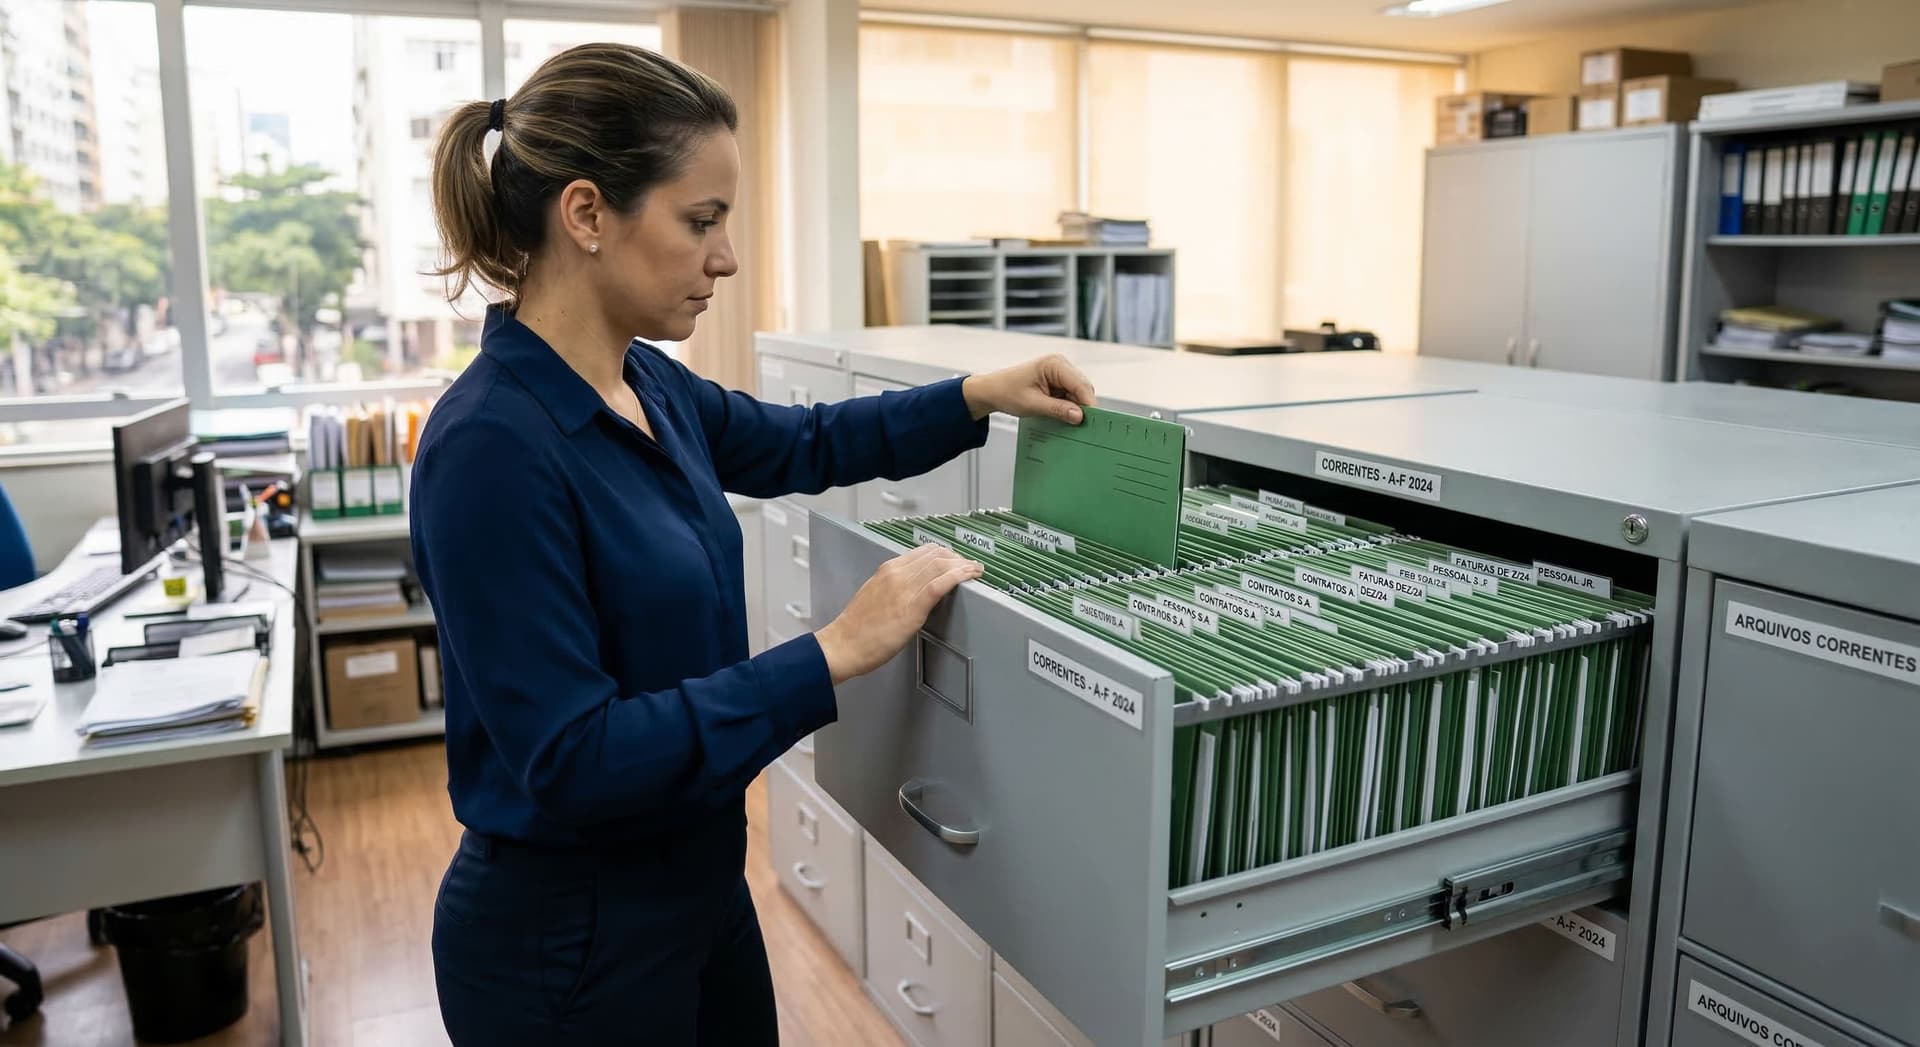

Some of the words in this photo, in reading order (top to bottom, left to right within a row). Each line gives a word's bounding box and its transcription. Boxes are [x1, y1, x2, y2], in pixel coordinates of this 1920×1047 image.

[1322, 458, 1380, 481] CORRENTES
[1388, 472, 1407, 487] A-F
[1408, 476, 1433, 493] 2024
[1433, 565, 1472, 584] PESSOAL
[1456, 558, 1495, 574] FATURAS
[1538, 567, 1579, 585] PESSOAL
[1248, 579, 1295, 603] CONTRATOS
[1302, 573, 1347, 595] CONTRATOS
[1359, 571, 1394, 589] FATURAS
[1199, 592, 1242, 616] CONTRATOS
[1734, 613, 1811, 645] ARQUIVOS
[1816, 634, 1917, 672] CORRENTES
[1033, 651, 1086, 690] CORRENTES
[1094, 682, 1110, 701] A-F
[1112, 692, 1135, 715] 2024
[1557, 915, 1576, 932] A-F
[1578, 926, 1606, 948] 2024
[1698, 994, 1769, 1039] ARQUIVOS
